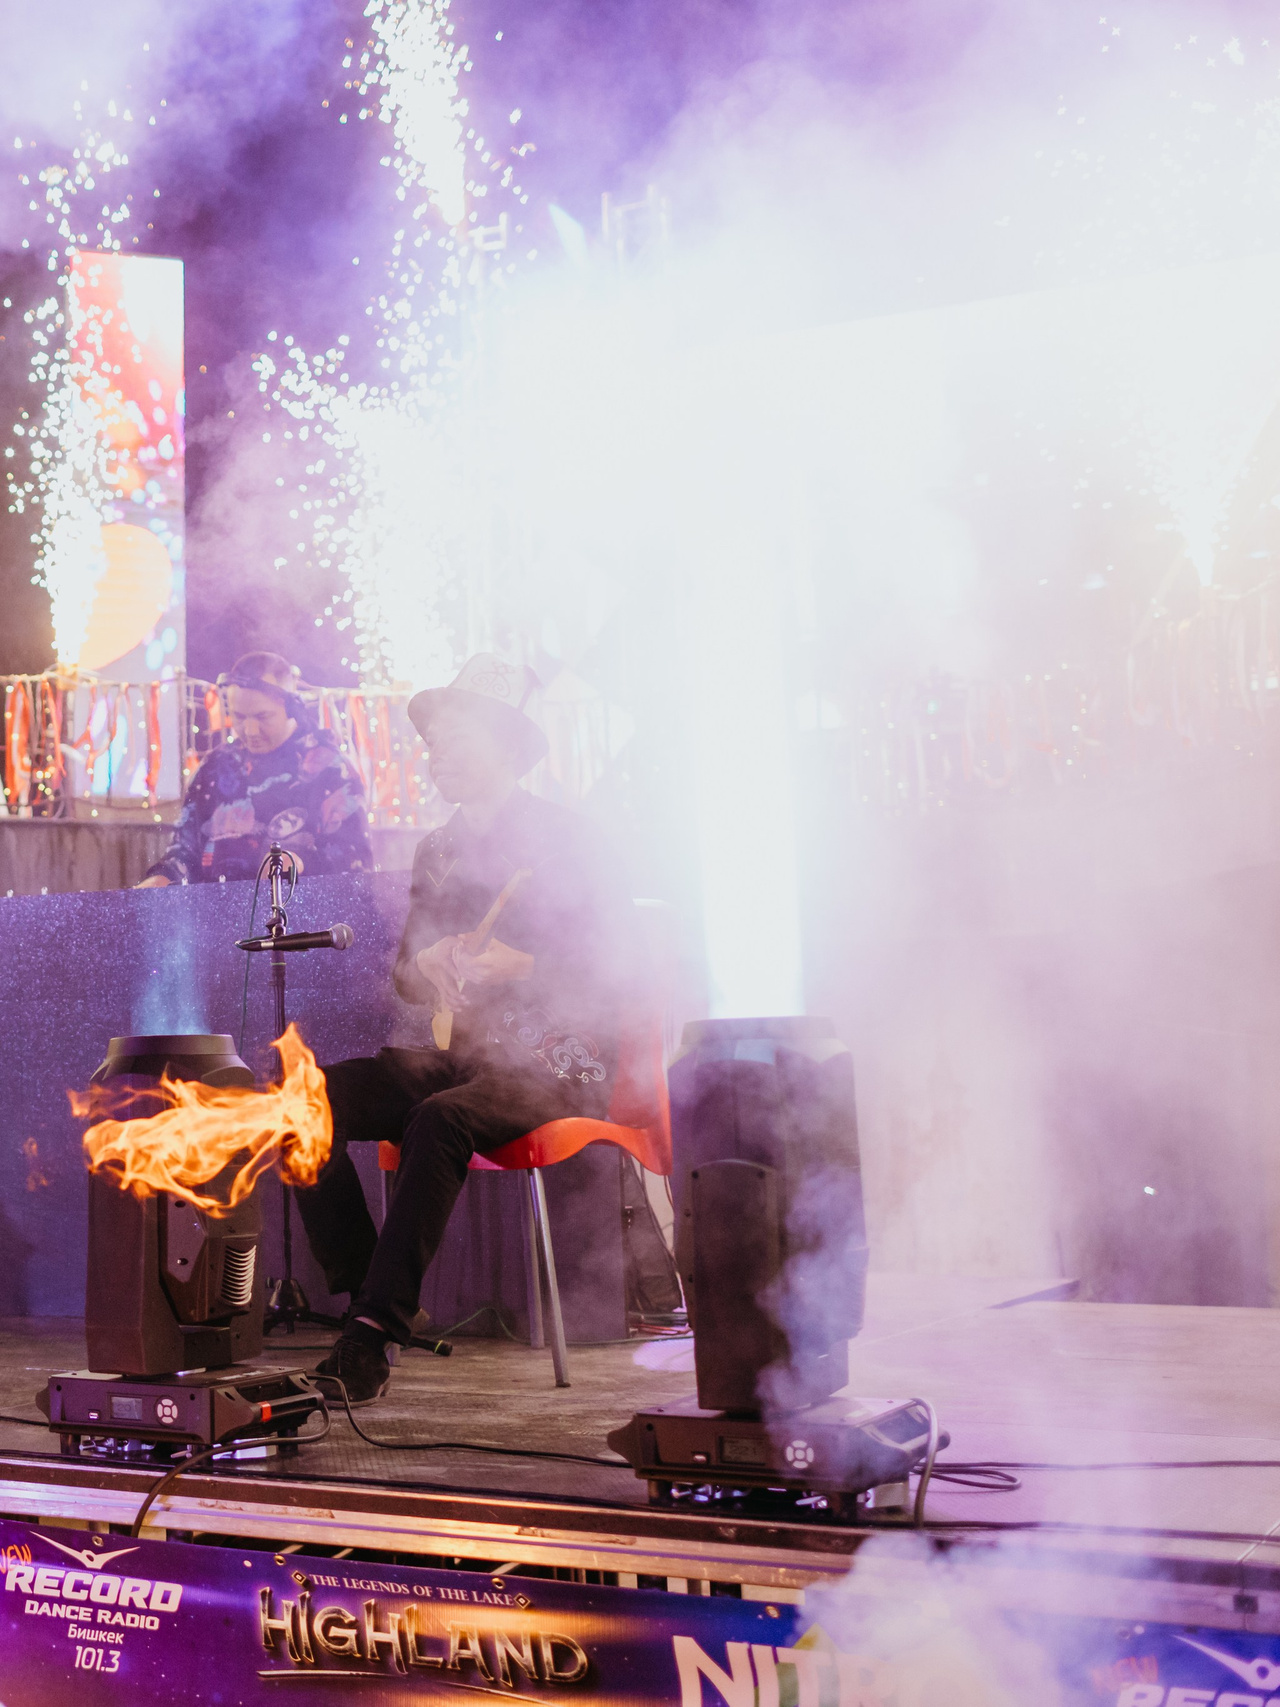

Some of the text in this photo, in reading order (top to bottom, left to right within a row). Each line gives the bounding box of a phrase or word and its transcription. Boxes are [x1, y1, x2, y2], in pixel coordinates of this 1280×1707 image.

[5, 1564, 183, 1613] RECORD
[309, 1574, 514, 1606] THE LEGENDS OF THE LAKE
[24, 1600, 160, 1631] DANCE RADIO
[67, 1623, 124, 1644] Бишкек
[259, 1587, 588, 1687] HIGHLAND
[75, 1646, 121, 1673] 101.3
